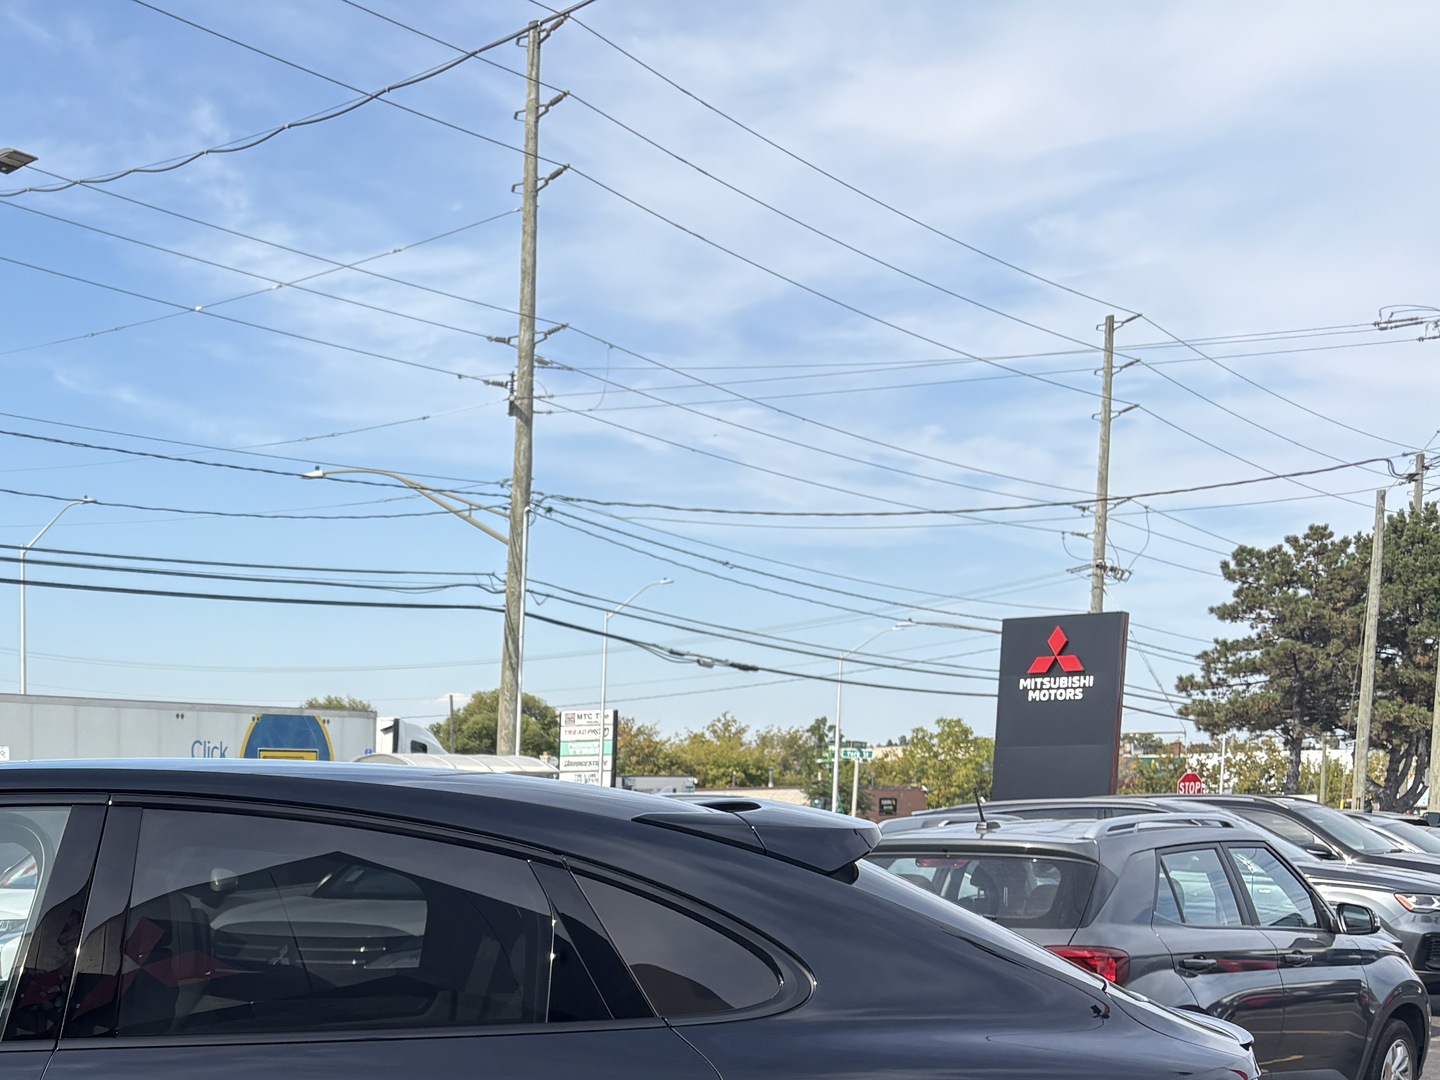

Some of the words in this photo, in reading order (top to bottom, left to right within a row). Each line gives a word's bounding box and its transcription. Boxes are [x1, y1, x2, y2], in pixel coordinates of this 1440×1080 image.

[1019, 675, 1094, 690] MITSUBISHI
[1027, 688, 1084, 702] MOTORS
[190, 739, 229, 759] Click
[1179, 781, 1201, 795] STOP
